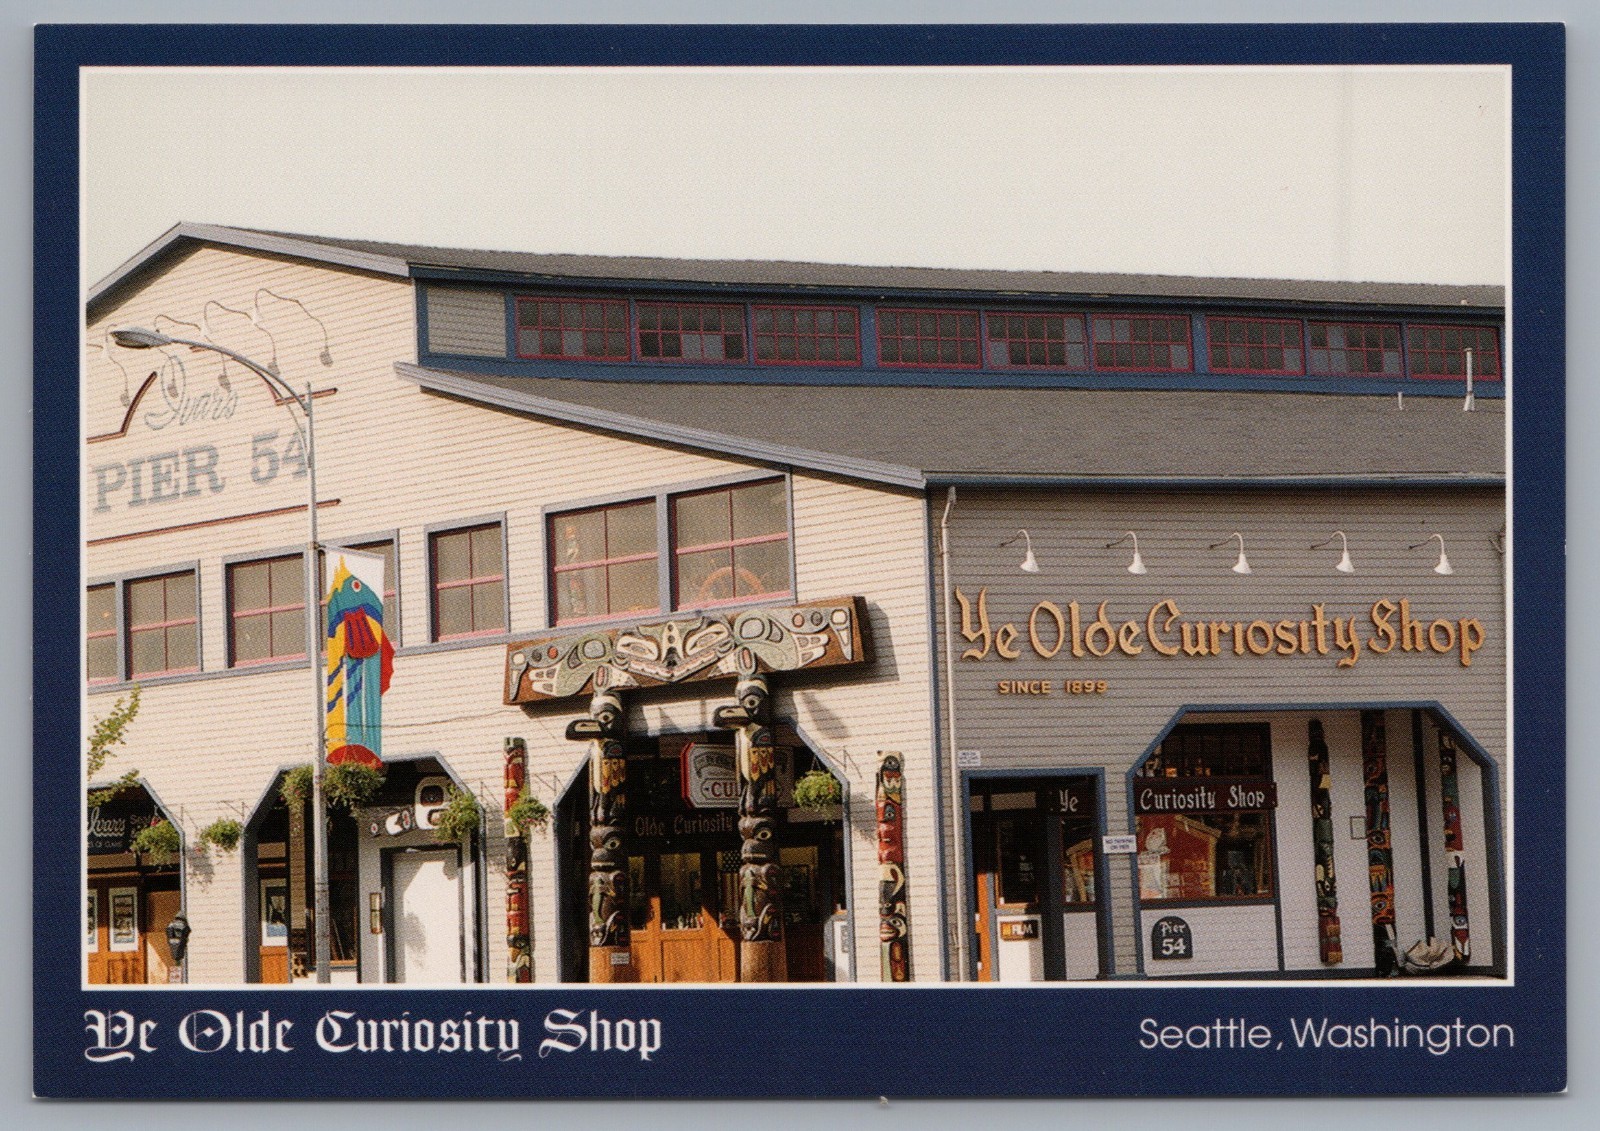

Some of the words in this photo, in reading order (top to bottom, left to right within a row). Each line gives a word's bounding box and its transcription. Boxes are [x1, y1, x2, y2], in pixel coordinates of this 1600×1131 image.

[92, 445, 226, 514] PIER
[251, 426, 308, 485] 54
[955, 586, 1021, 660] Ye
[1029, 600, 1143, 658] Olde
[1147, 599, 1361, 667] Curiosity
[1367, 598, 1486, 666] Shop
[998, 680, 1051, 694] SINCE
[1065, 680, 1108, 693] 1899
[1059, 789, 1079, 812] Ye
[1140, 786, 1216, 810] Curiosity
[1227, 785, 1265, 808] Shop
[634, 815, 665, 837] Olde
[672, 811, 733, 835] Curiosity
[1011, 923, 1034, 936] FILM
[1159, 921, 1186, 937] Pier
[1161, 938, 1186, 956] 54
[84, 1010, 158, 1062] Ye
[178, 1009, 295, 1053] Olde
[315, 1010, 522, 1062] Curiosity
[538, 1008, 662, 1061] Shop
[1139, 1018, 1283, 1051] Seattle,
[1290, 1017, 1514, 1056] Washington
